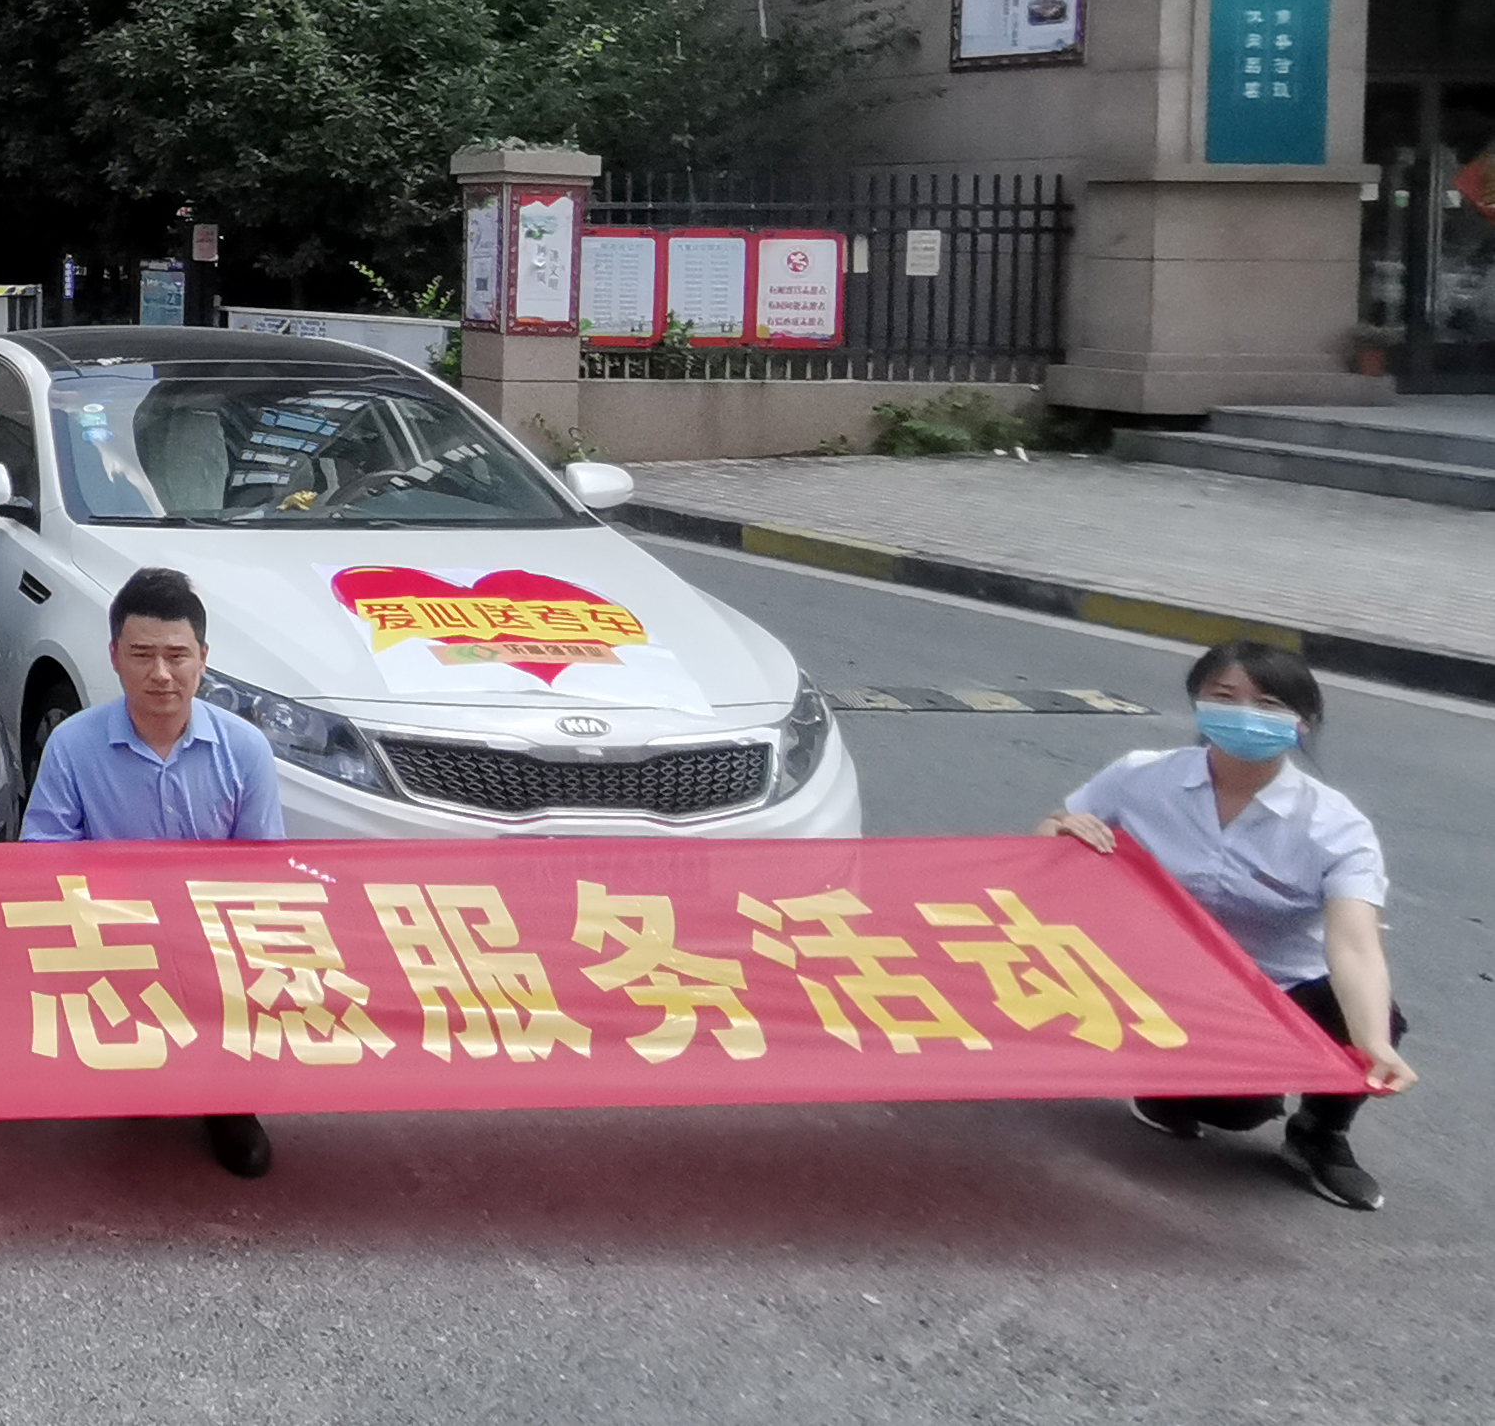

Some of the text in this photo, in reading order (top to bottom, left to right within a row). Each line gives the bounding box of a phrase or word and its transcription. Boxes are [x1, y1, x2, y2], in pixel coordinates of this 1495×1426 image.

[362, 603, 644, 636] 爱心送考车
